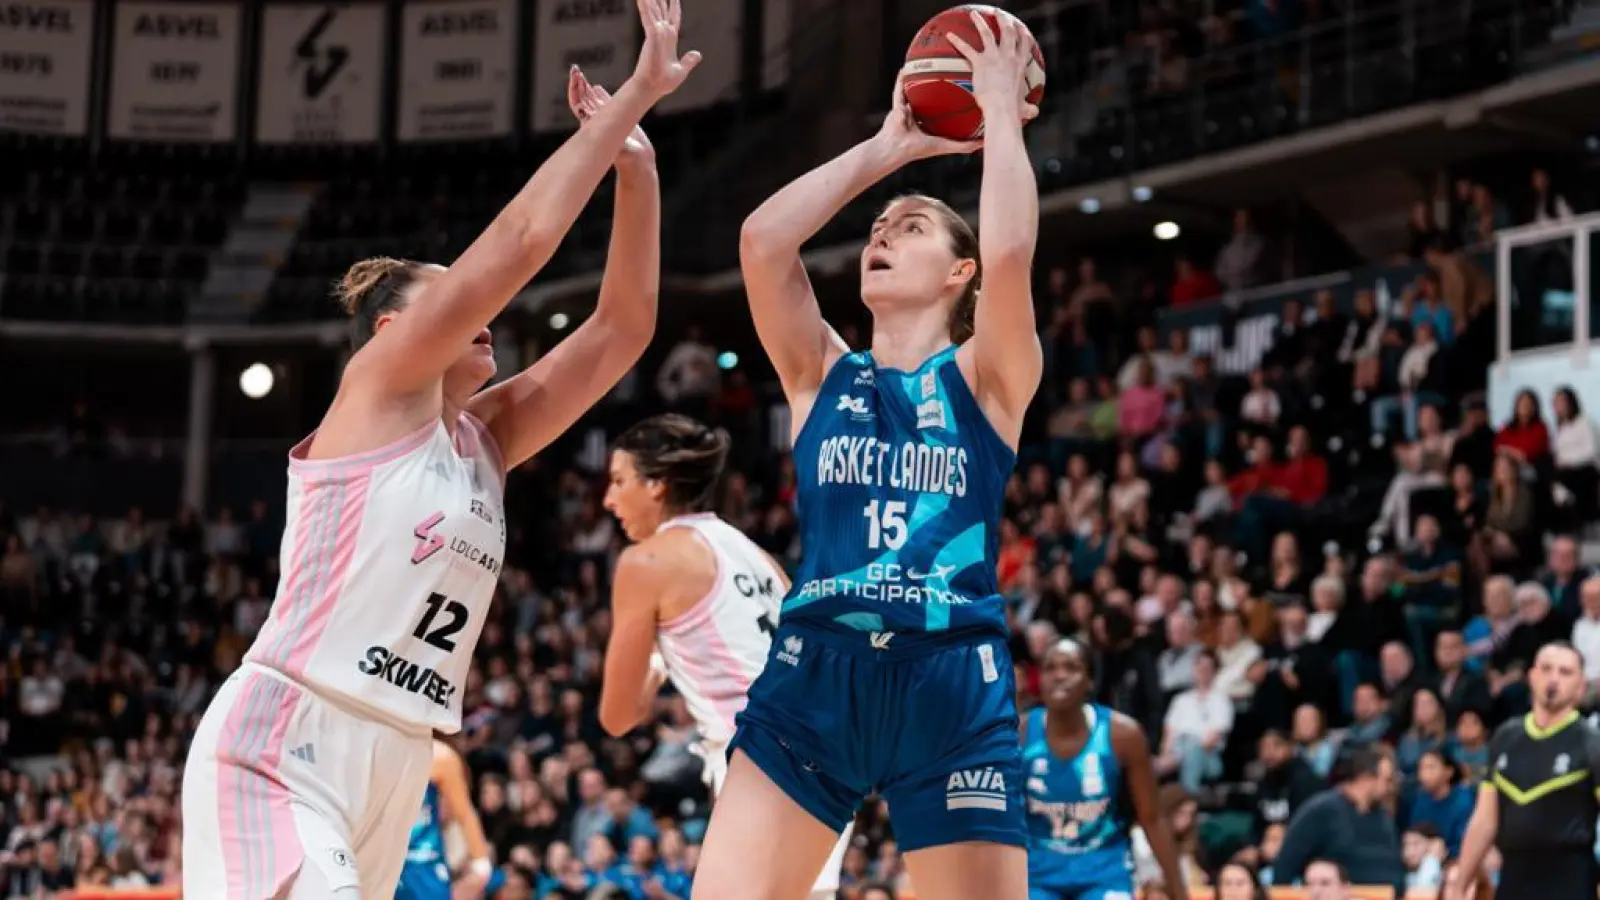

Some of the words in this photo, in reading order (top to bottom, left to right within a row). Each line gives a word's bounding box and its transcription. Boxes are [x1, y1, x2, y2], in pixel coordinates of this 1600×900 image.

[134, 13, 219, 38] ASVEL
[889, 441, 968, 498] LANDES
[863, 499, 909, 551] 15
[866, 563, 901, 582] GC
[412, 591, 469, 653] 12
